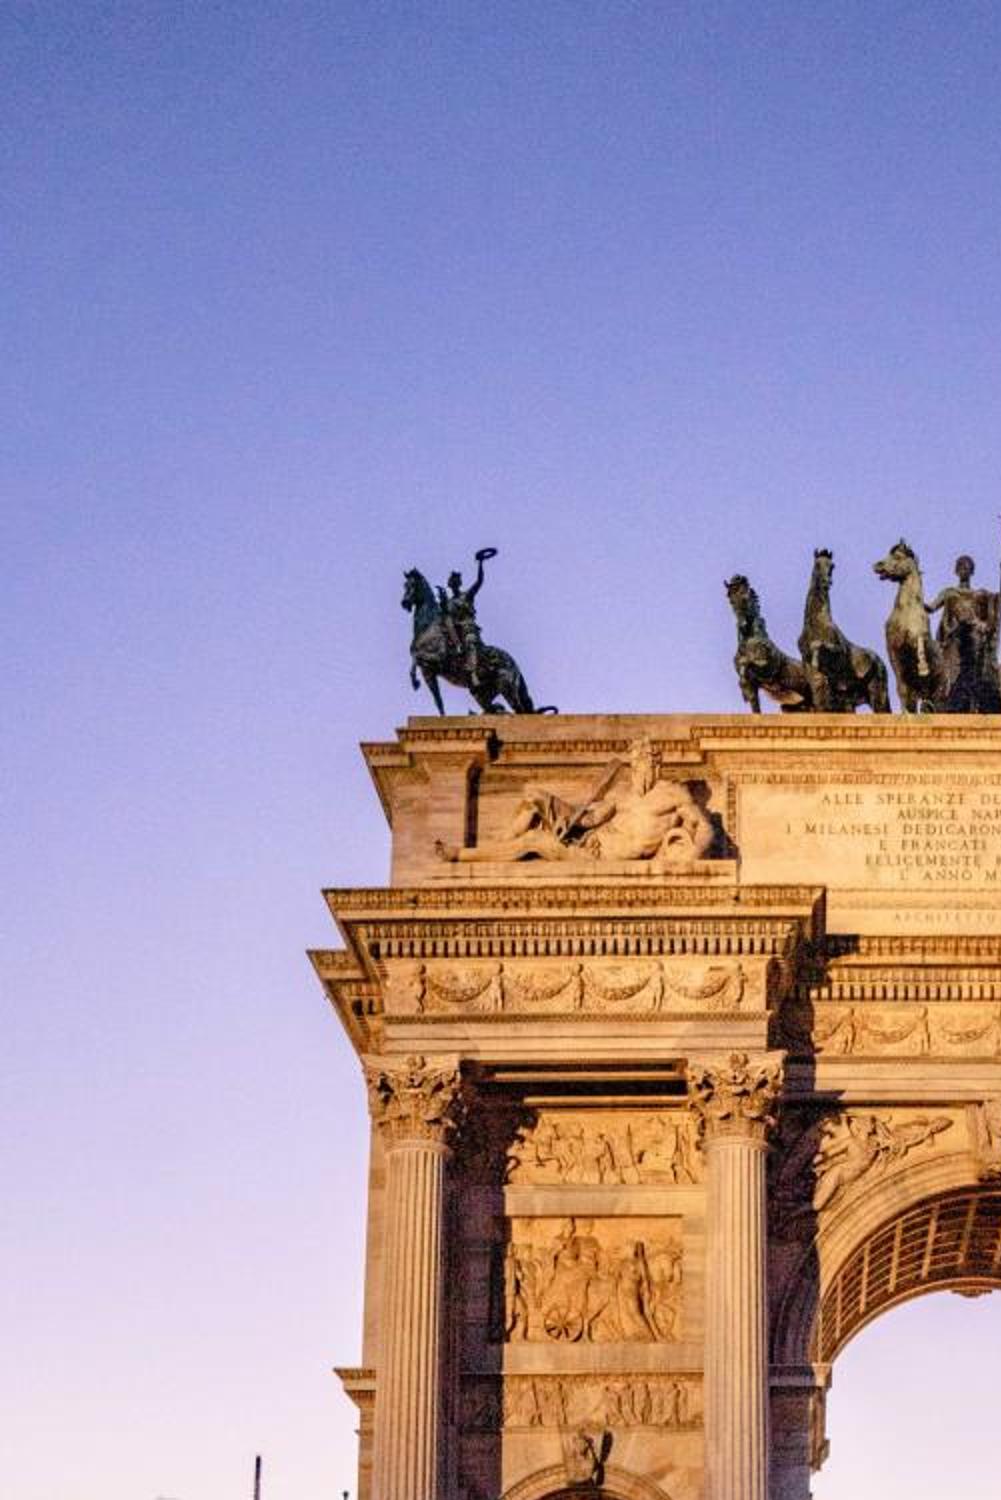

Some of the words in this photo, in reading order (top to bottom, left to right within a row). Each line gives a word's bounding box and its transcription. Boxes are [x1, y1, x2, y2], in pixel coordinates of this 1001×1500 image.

[821, 793, 864, 805] ALLE
[897, 808, 958, 821] AUSPICE
[804, 823, 888, 835] MILANESI
[901, 839, 987, 851] FRANCATI
